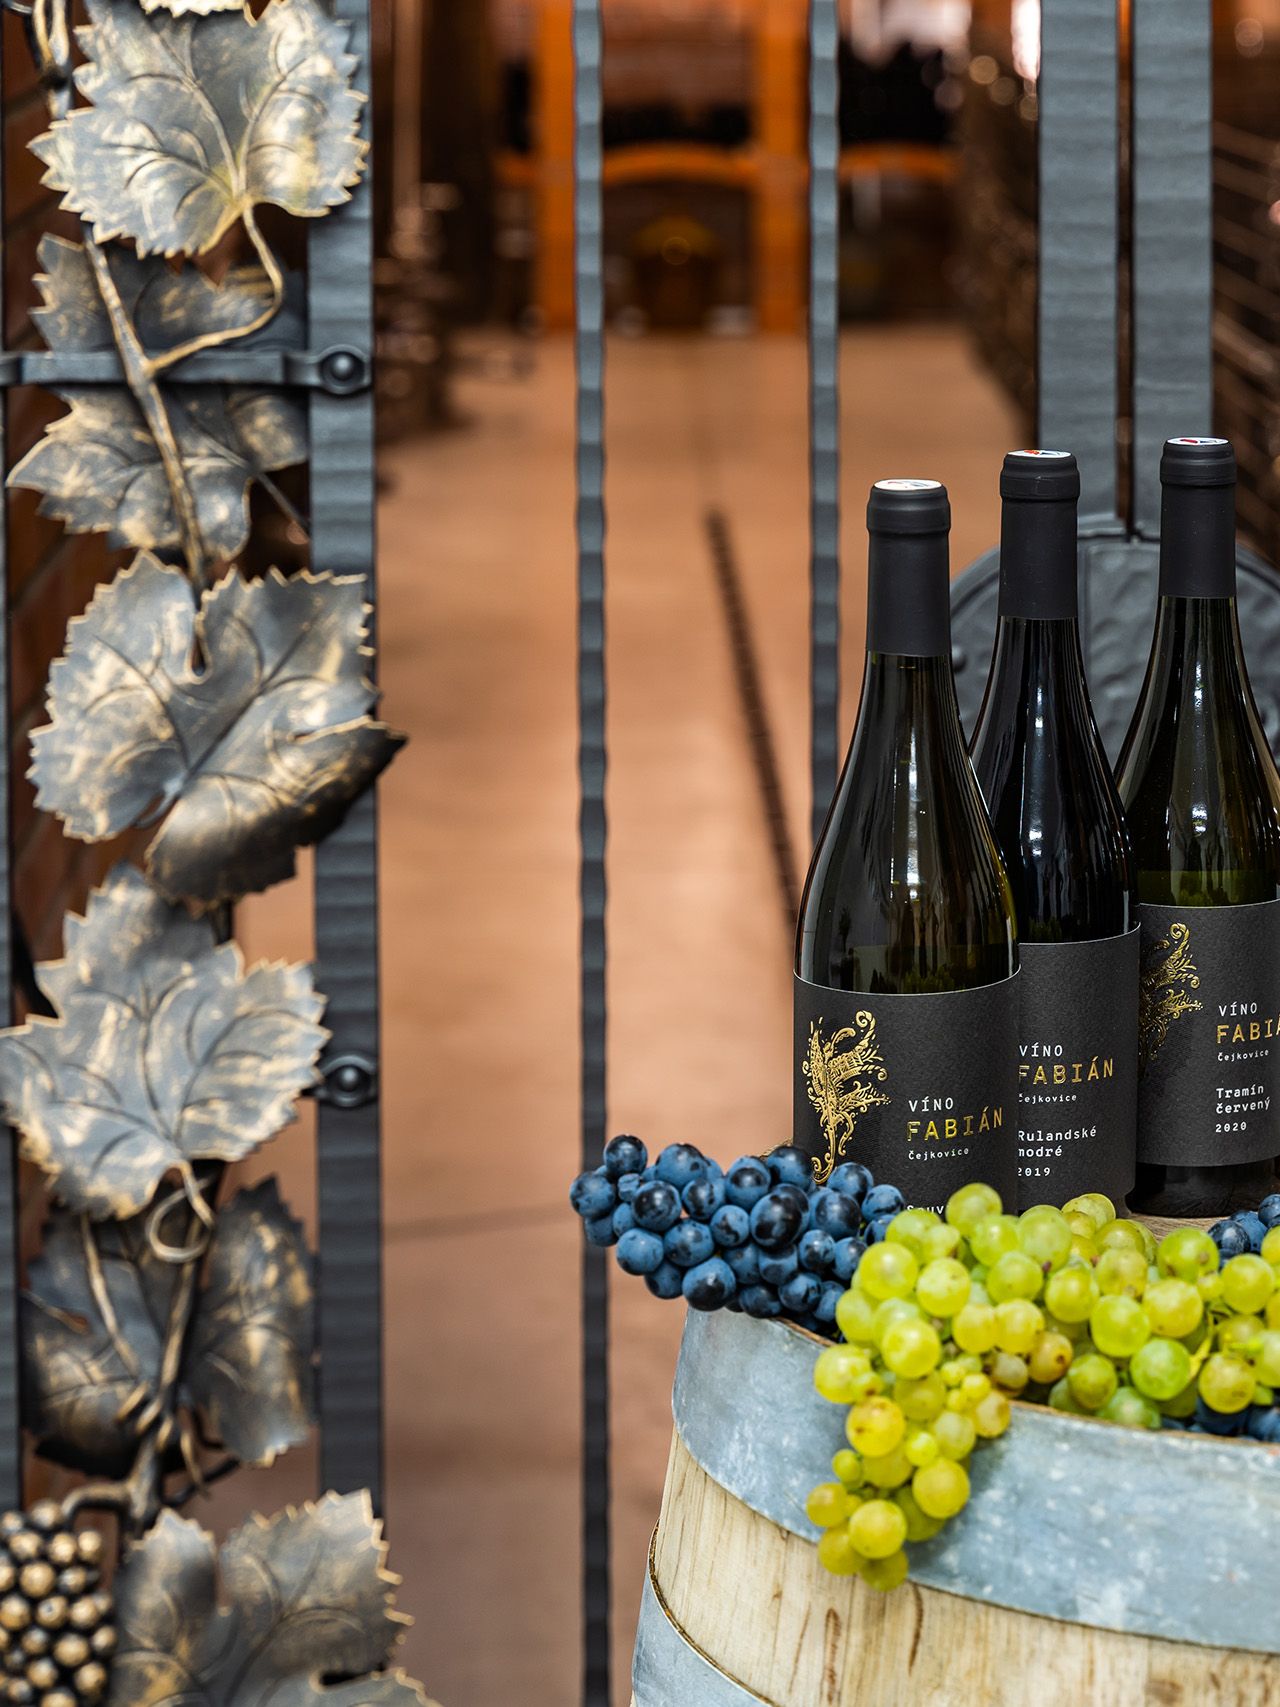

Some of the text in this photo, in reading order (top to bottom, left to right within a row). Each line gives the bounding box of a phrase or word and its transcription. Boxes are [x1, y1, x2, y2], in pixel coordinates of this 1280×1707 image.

[1219, 1001, 1258, 1016] VÍNO
[1019, 1042, 1063, 1058] VÍNO
[1218, 1049, 1269, 1062] Čejkovice
[1216, 1084, 1264, 1099] Tramín
[908, 1096, 954, 1113] VÍNO
[1216, 1096, 1270, 1114] červený
[906, 1105, 1003, 1142] FABIÁN
[1215, 1121, 1247, 1133] 2020
[1018, 1125, 1097, 1142] Rulandské
[908, 1147, 969, 1161] Čejkovice
